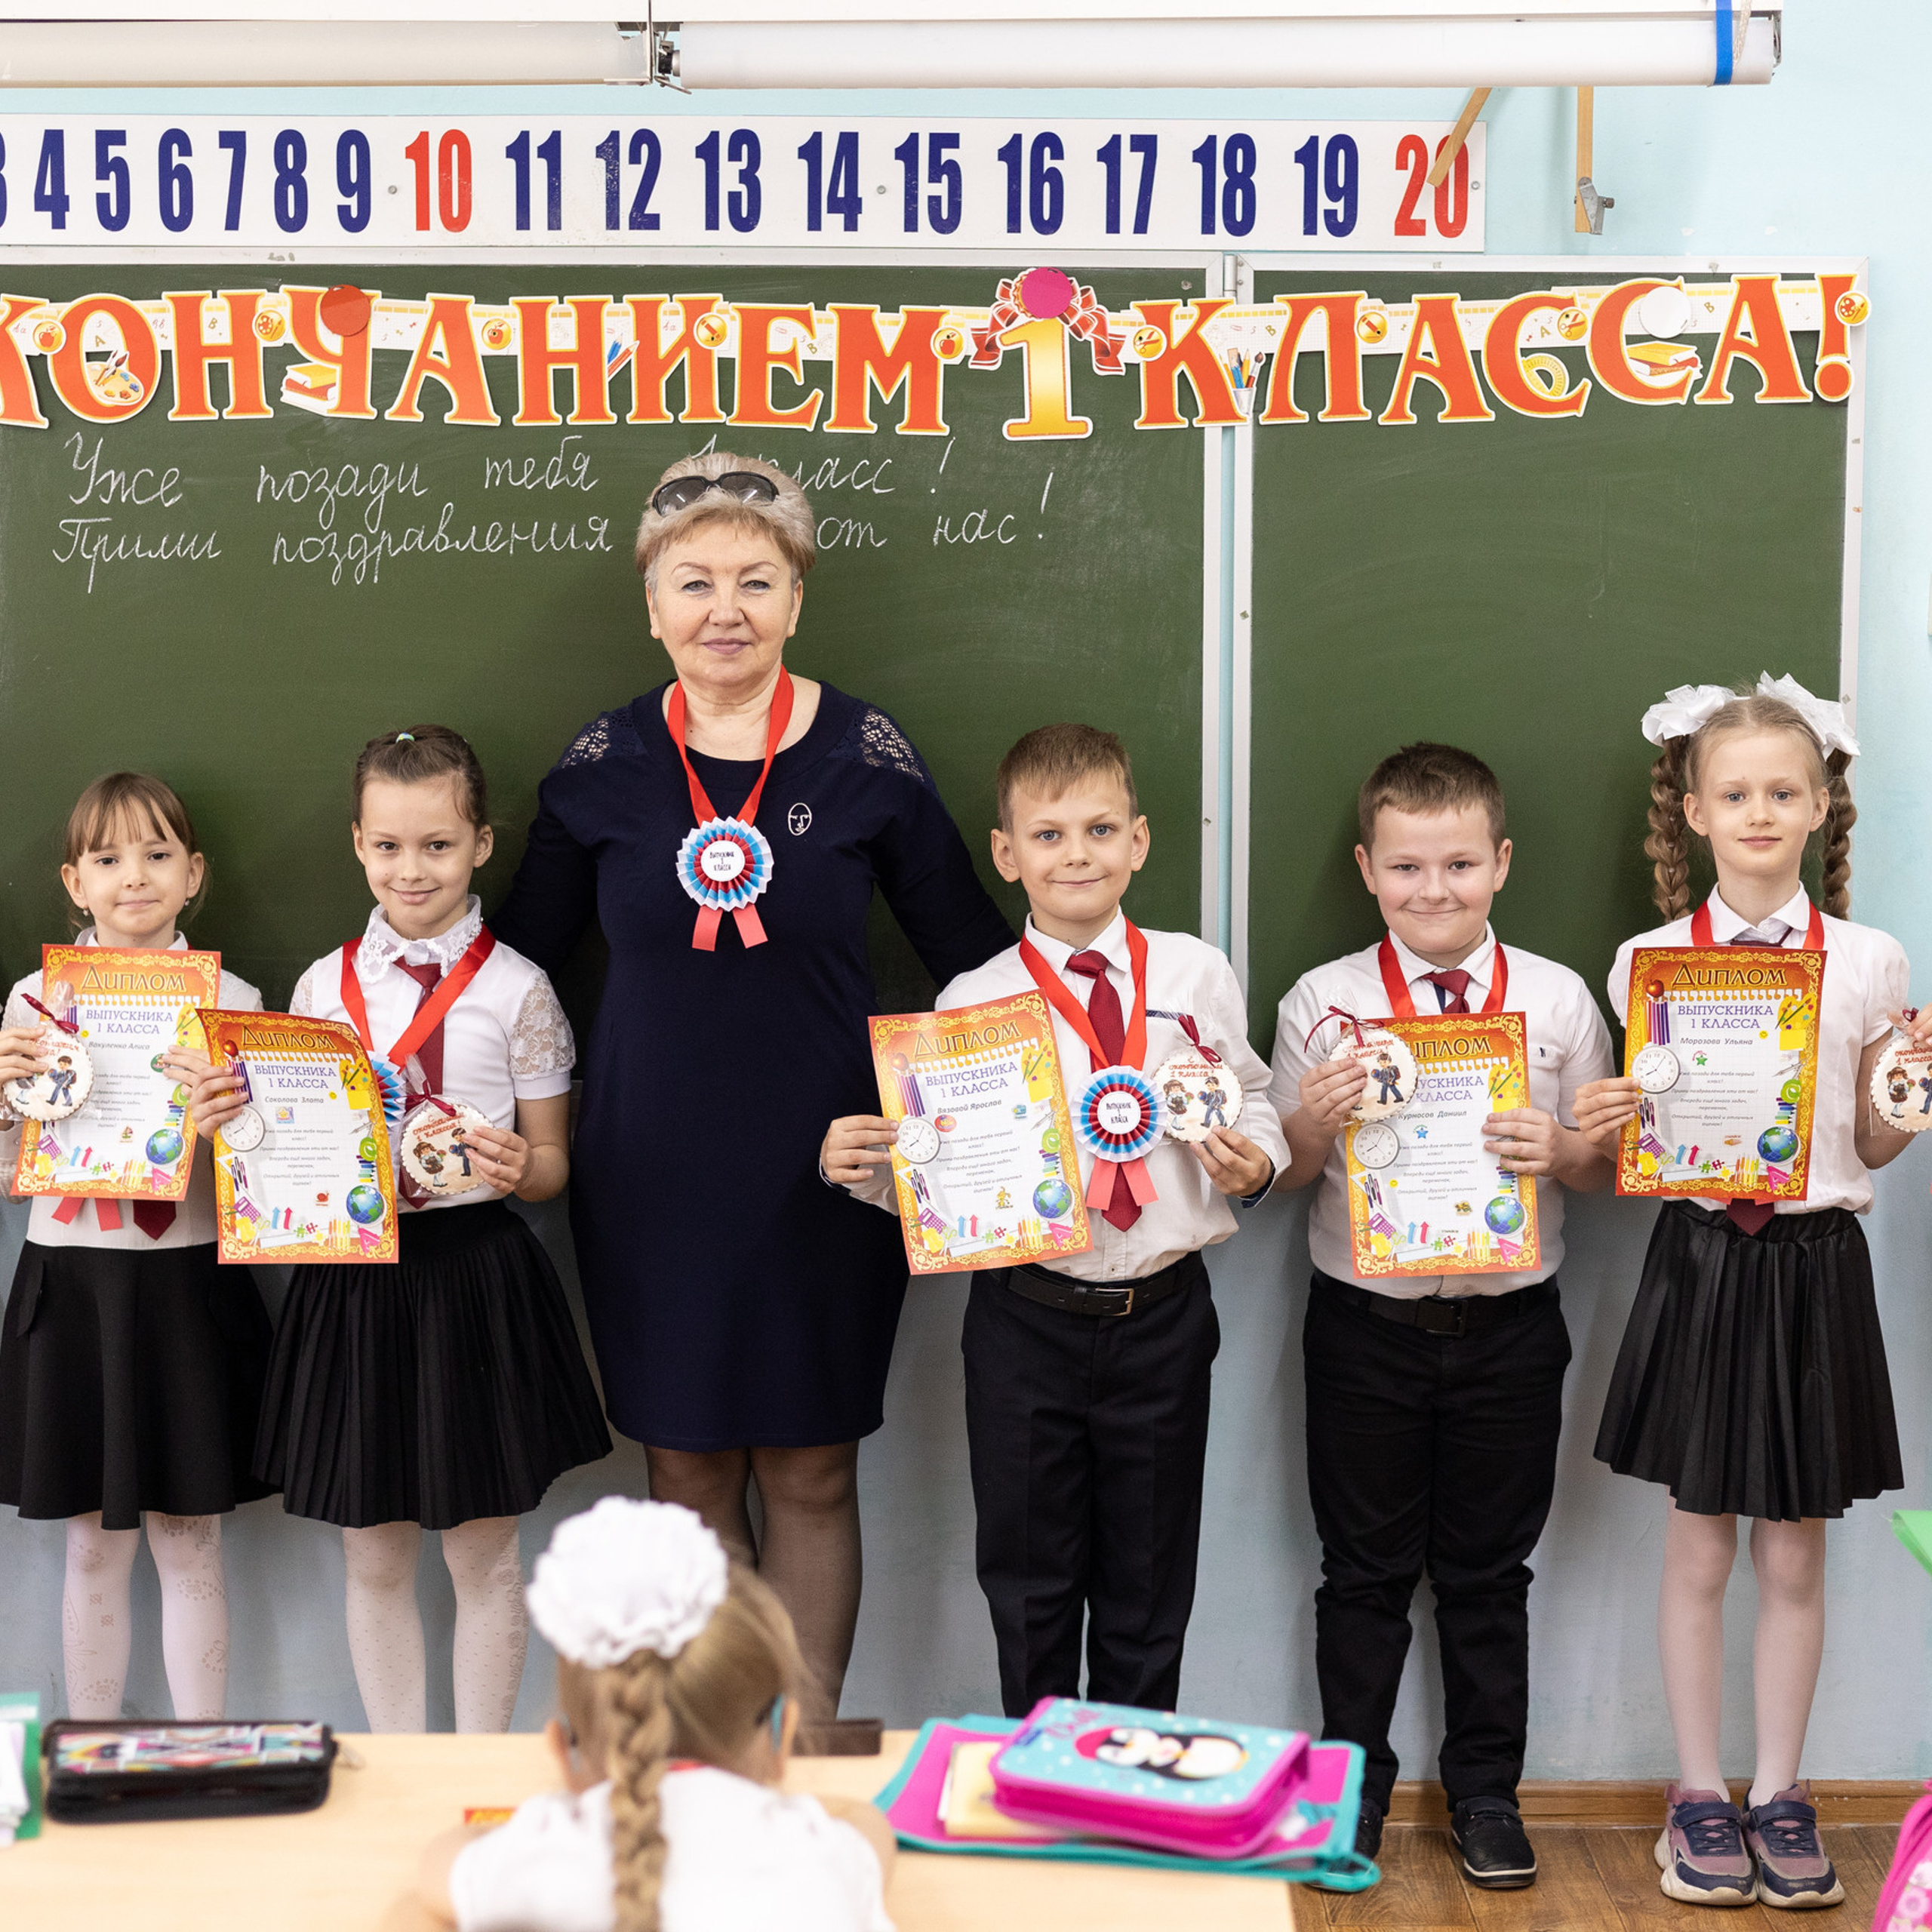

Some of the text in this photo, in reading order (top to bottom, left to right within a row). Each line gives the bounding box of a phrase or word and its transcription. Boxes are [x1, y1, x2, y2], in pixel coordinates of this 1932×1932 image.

[34, 129, 69, 229] 4
[95, 130, 130, 232] 5
[158, 128, 192, 232] 6
[218, 131, 247, 230] 7
[274, 129, 308, 232] 8
[337, 129, 371, 232] 9
[405, 129, 472, 232] 10
[505, 130, 562, 231] 11
[595, 128, 661, 231] 12
[694, 129, 762, 232] 13
[798, 131, 863, 232] 14
[894, 132, 962, 234] 15
[997, 131, 1064, 235] 16
[1097, 134, 1158, 234] 17
[1192, 133, 1257, 236] 18
[1294, 134, 1359, 237] 19
[1394, 134, 1469, 238] 20
[999, 317, 1092, 441] 1
[1134, 273, 1857, 428] КЛАССА!
[64, 432, 183, 507] Уже
[257, 462, 428, 534] позади
[485, 435, 598, 491] тебя
[53, 517, 221, 594] Прими
[273, 503, 613, 586] поздравления
[817, 517, 888, 549] от
[934, 509, 1016, 546] нас
[82, 965, 186, 992] Диплом
[1672, 964, 1787, 988] Диплом
[86, 1009, 174, 1023] ВЫПУСКНИКА
[1678, 1004, 1774, 1015] ВЫПУСКНИКА
[97, 1023, 161, 1035] 1 КЛАССА
[1690, 1018, 1761, 1029] 1 КЛАССА
[242, 1024, 337, 1050] Диплом
[914, 1021, 1023, 1058] Диплом
[1414, 1036, 1491, 1058] плом
[254, 1064, 337, 1077] ВЫПУСКНИКА
[925, 1061, 1018, 1087] ВЫПУСКНИКА
[268, 1078, 329, 1088] 1 КЛАССА
[941, 1078, 1009, 1098] 1 КЛАССА
[1415, 1076, 1484, 1089] УСКНИКА
[971, 1100, 1002, 1111] Ярослав
[1417, 1091, 1473, 1103] КЛАССА
